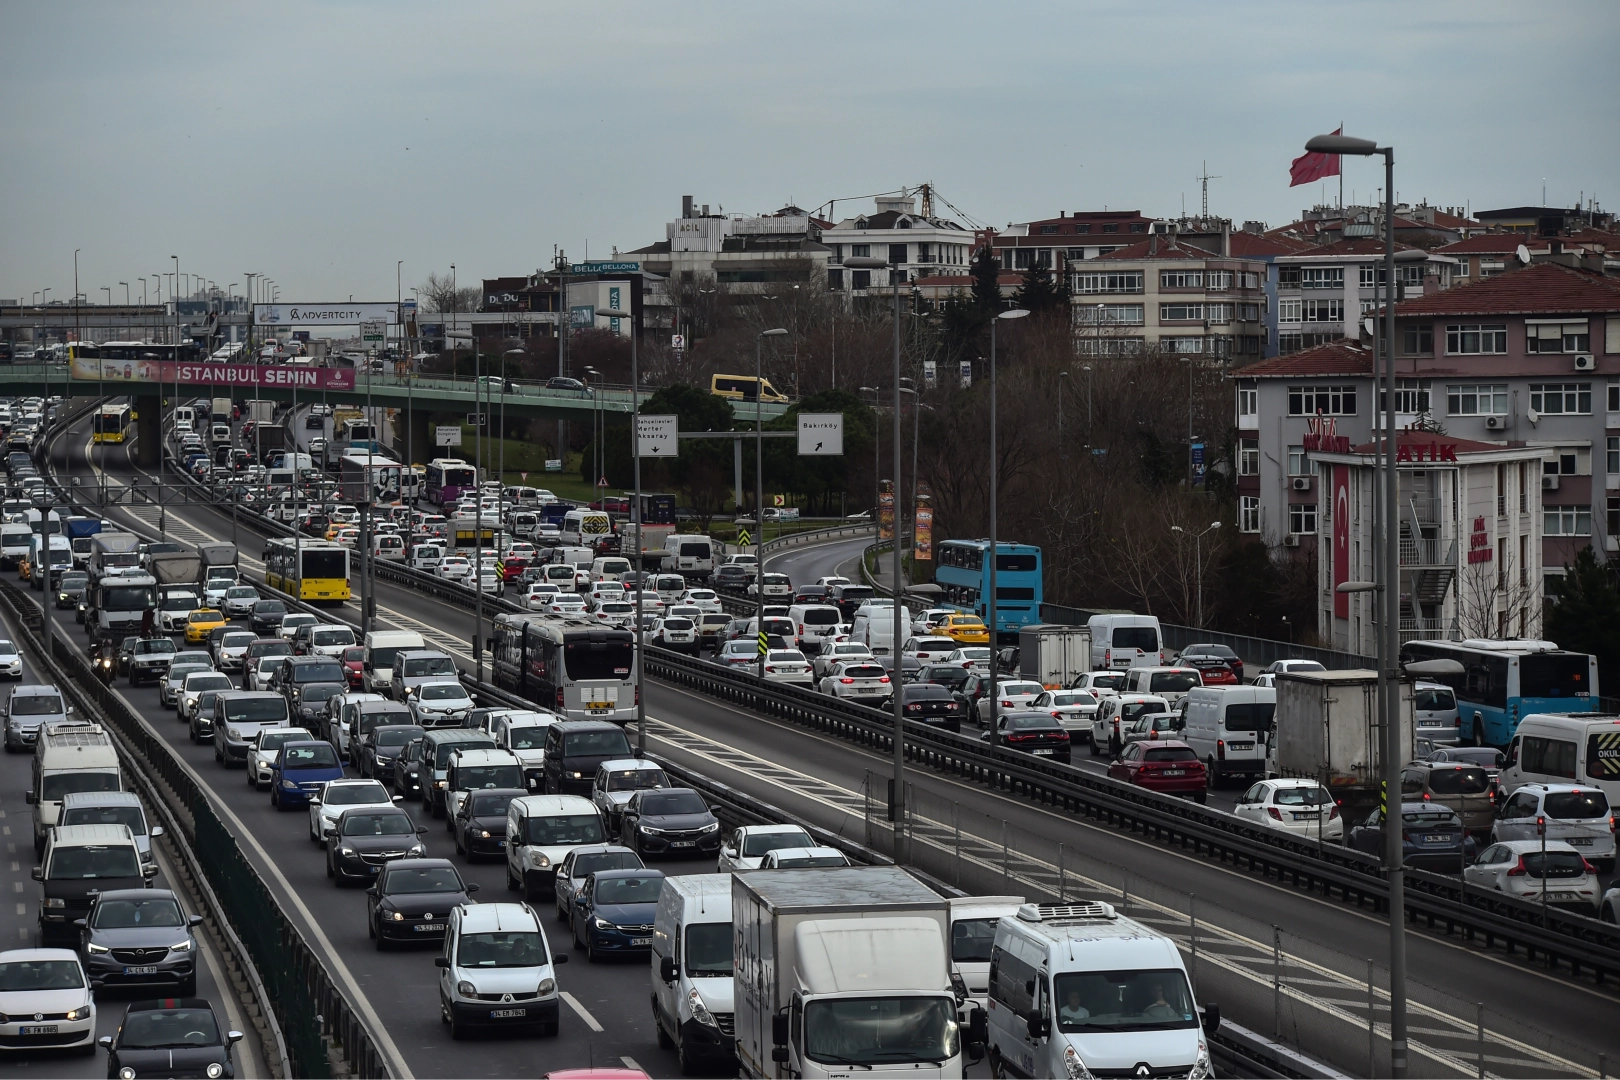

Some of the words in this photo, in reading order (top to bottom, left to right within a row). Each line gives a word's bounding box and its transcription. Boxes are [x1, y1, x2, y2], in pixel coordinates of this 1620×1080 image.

[803, 422, 838, 430] Bakırköy
[1396, 441, 1458, 461] ATİK
[1598, 750, 1620, 758] OKUL
